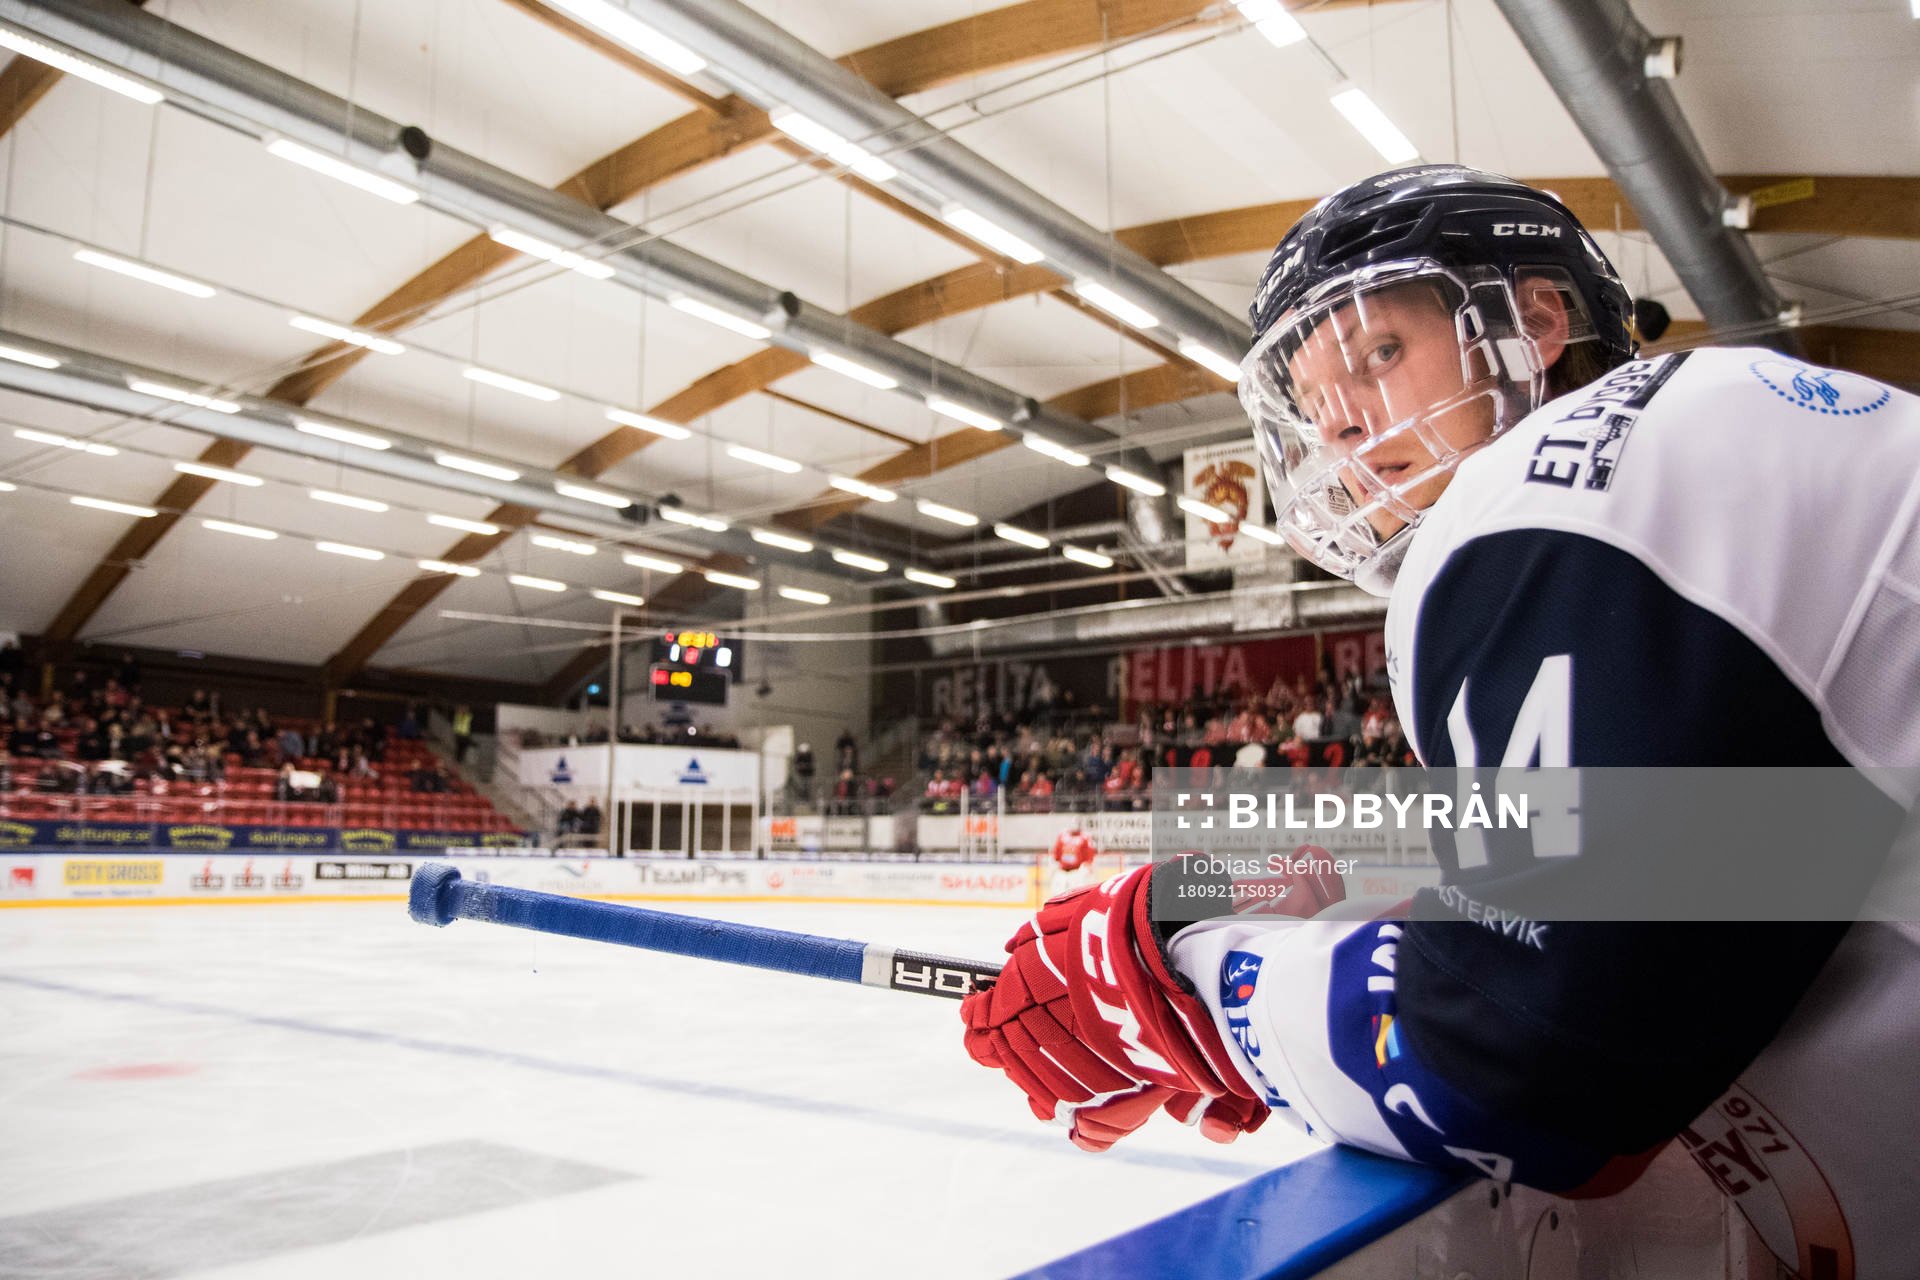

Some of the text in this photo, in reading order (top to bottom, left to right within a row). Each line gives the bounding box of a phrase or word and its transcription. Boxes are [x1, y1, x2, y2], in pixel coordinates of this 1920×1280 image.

[1491, 223, 1561, 238] CCM
[1256, 246, 1305, 314] CCM
[1447, 654, 1582, 869] 14
[66, 862, 161, 882] CITY GROSS
[940, 874, 1025, 891] SHARP
